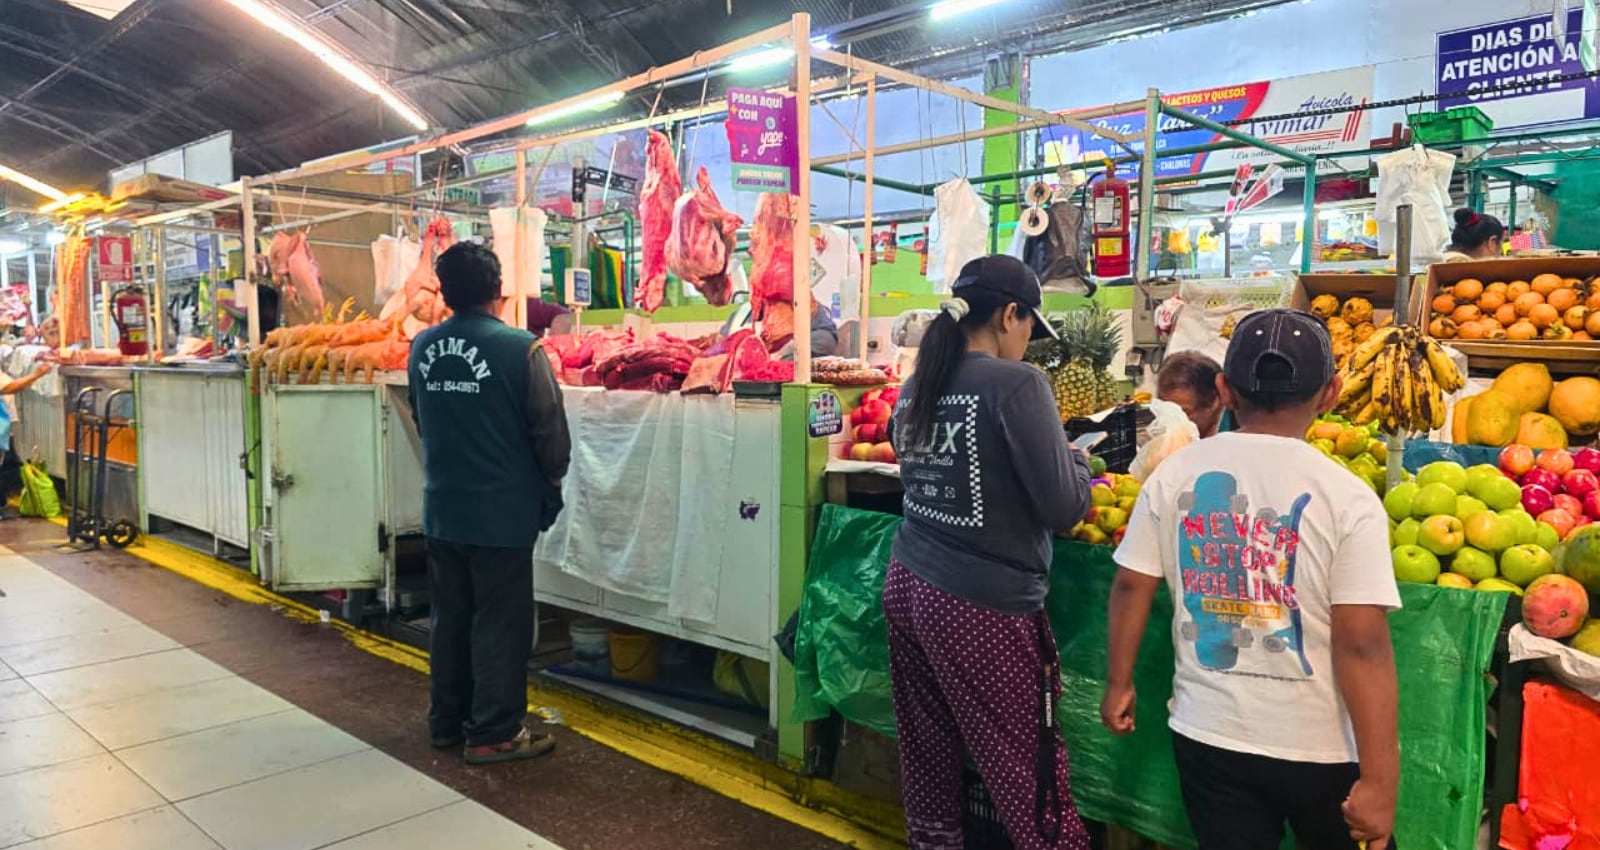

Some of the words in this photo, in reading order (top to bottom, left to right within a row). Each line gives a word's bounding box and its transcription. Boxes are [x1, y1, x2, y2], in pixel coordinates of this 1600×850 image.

[1471, 27, 1523, 53] DIAS
[1441, 45, 1554, 81] ATENCIÓN
[1561, 41, 1582, 63] A
[731, 92, 758, 105] PAGA
[1203, 92, 1211, 102] Y
[1211, 87, 1247, 102] QUESOS
[1467, 69, 1562, 100] CLIENTE
[738, 109, 758, 121] CON
[758, 131, 784, 156] yape
[418, 336, 491, 381] AFIMAN
[1181, 512, 1300, 556] NEVER
[1203, 542, 1277, 573] STOP
[1183, 568, 1300, 610] ROLLING
